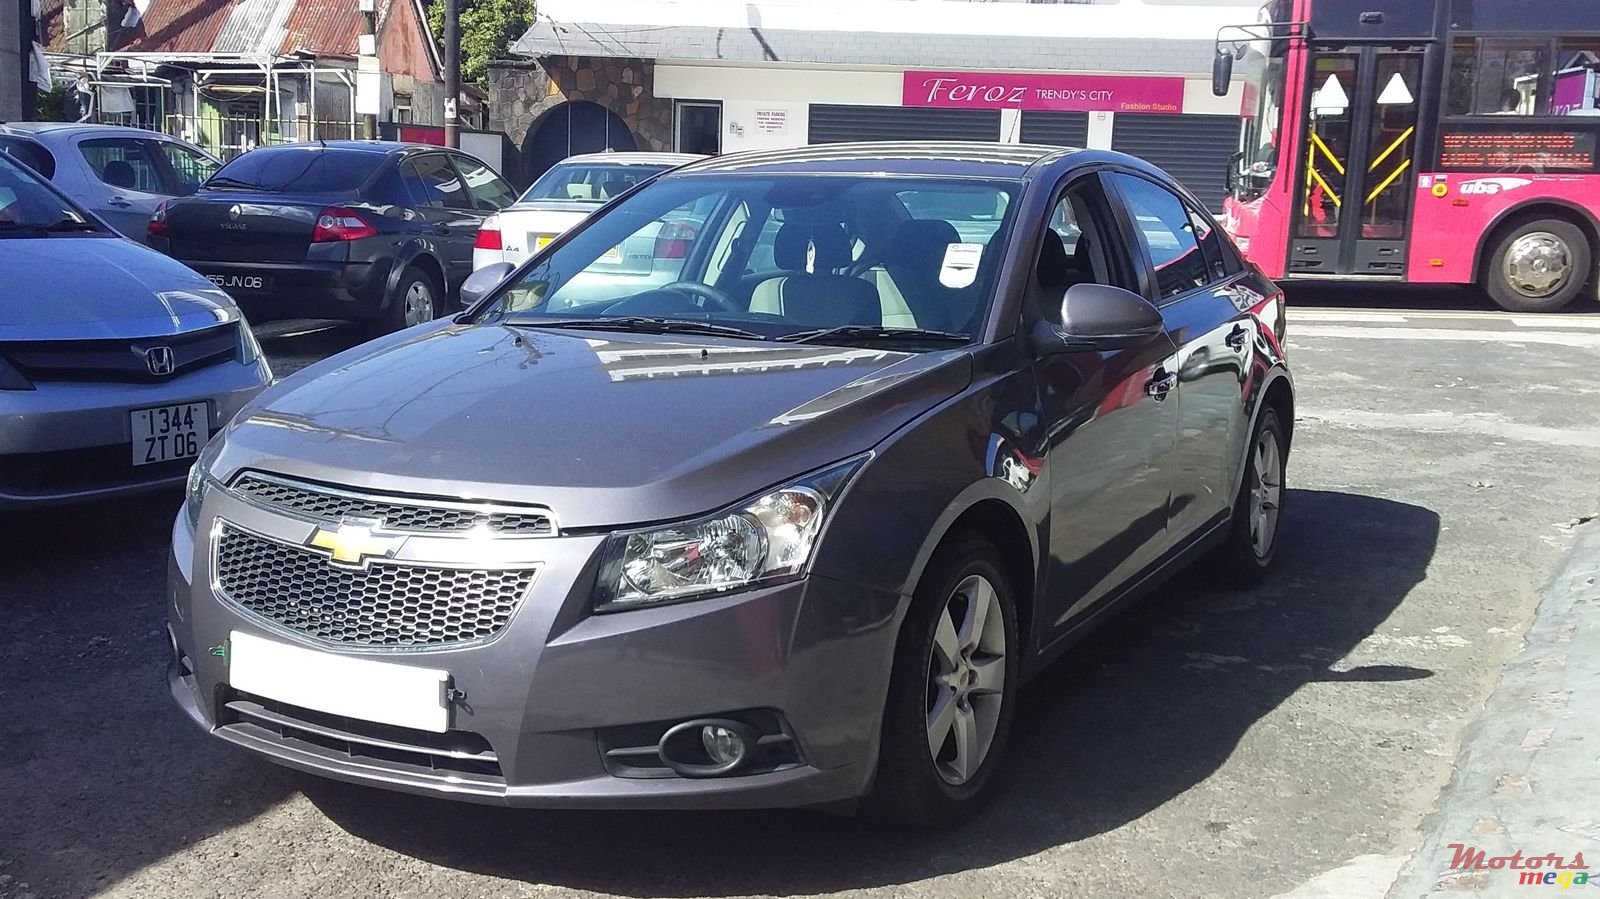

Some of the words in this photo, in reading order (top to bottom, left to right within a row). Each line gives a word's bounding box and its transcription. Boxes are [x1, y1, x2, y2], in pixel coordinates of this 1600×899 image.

[922, 78, 1027, 102] Feroz
[1036, 89, 1086, 100] TRENDY'S
[1089, 91, 1114, 101] CITY
[1121, 102, 1151, 110] Fashion
[1152, 103, 1177, 111] Studio
[1460, 181, 1499, 194] ubs
[225, 275, 243, 287] JN
[244, 276, 263, 288] 06
[149, 405, 194, 435] 1344
[145, 435, 168, 462] ZT
[174, 431, 197, 457] 06
